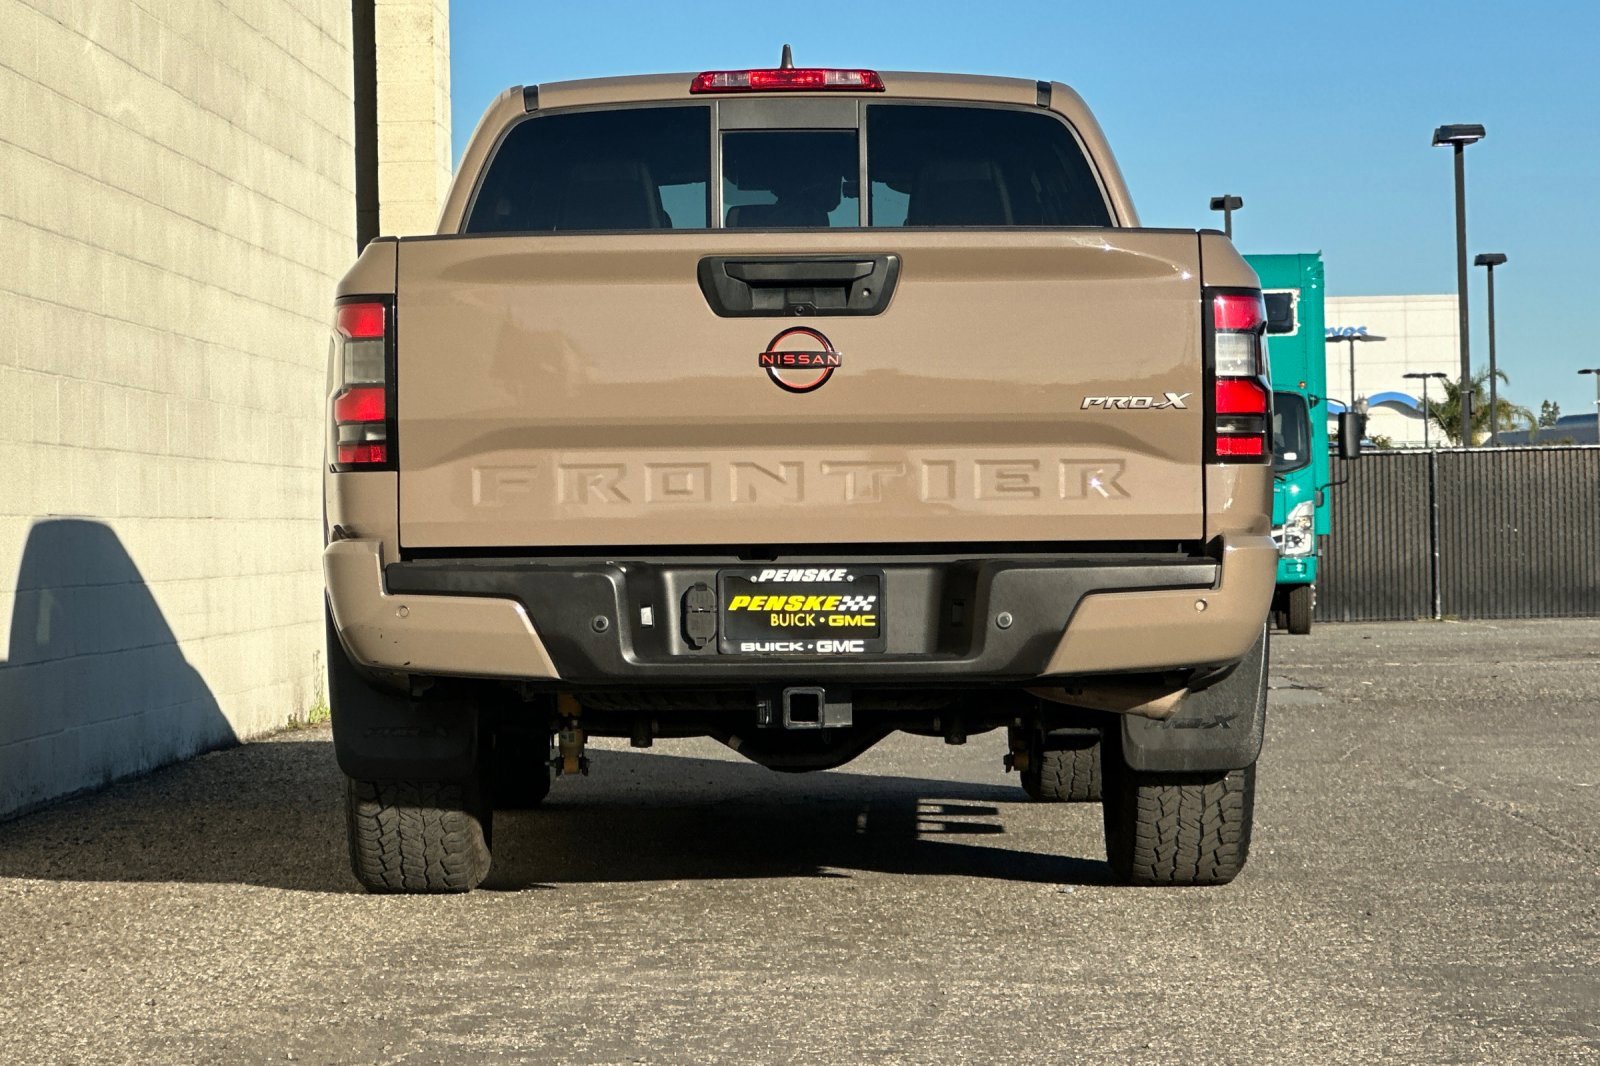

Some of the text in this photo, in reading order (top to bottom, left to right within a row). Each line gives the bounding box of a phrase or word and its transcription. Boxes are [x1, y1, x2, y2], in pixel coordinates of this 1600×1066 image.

[761, 354, 839, 365] NISSAN
[1080, 392, 1192, 409] PRO-X
[471, 458, 1131, 504] FRONTIER
[758, 568, 847, 582] PENSKE
[728, 595, 843, 611] PENSKE
[770, 613, 876, 627] BUICK GMC
[740, 640, 864, 653] BUICK GMC
